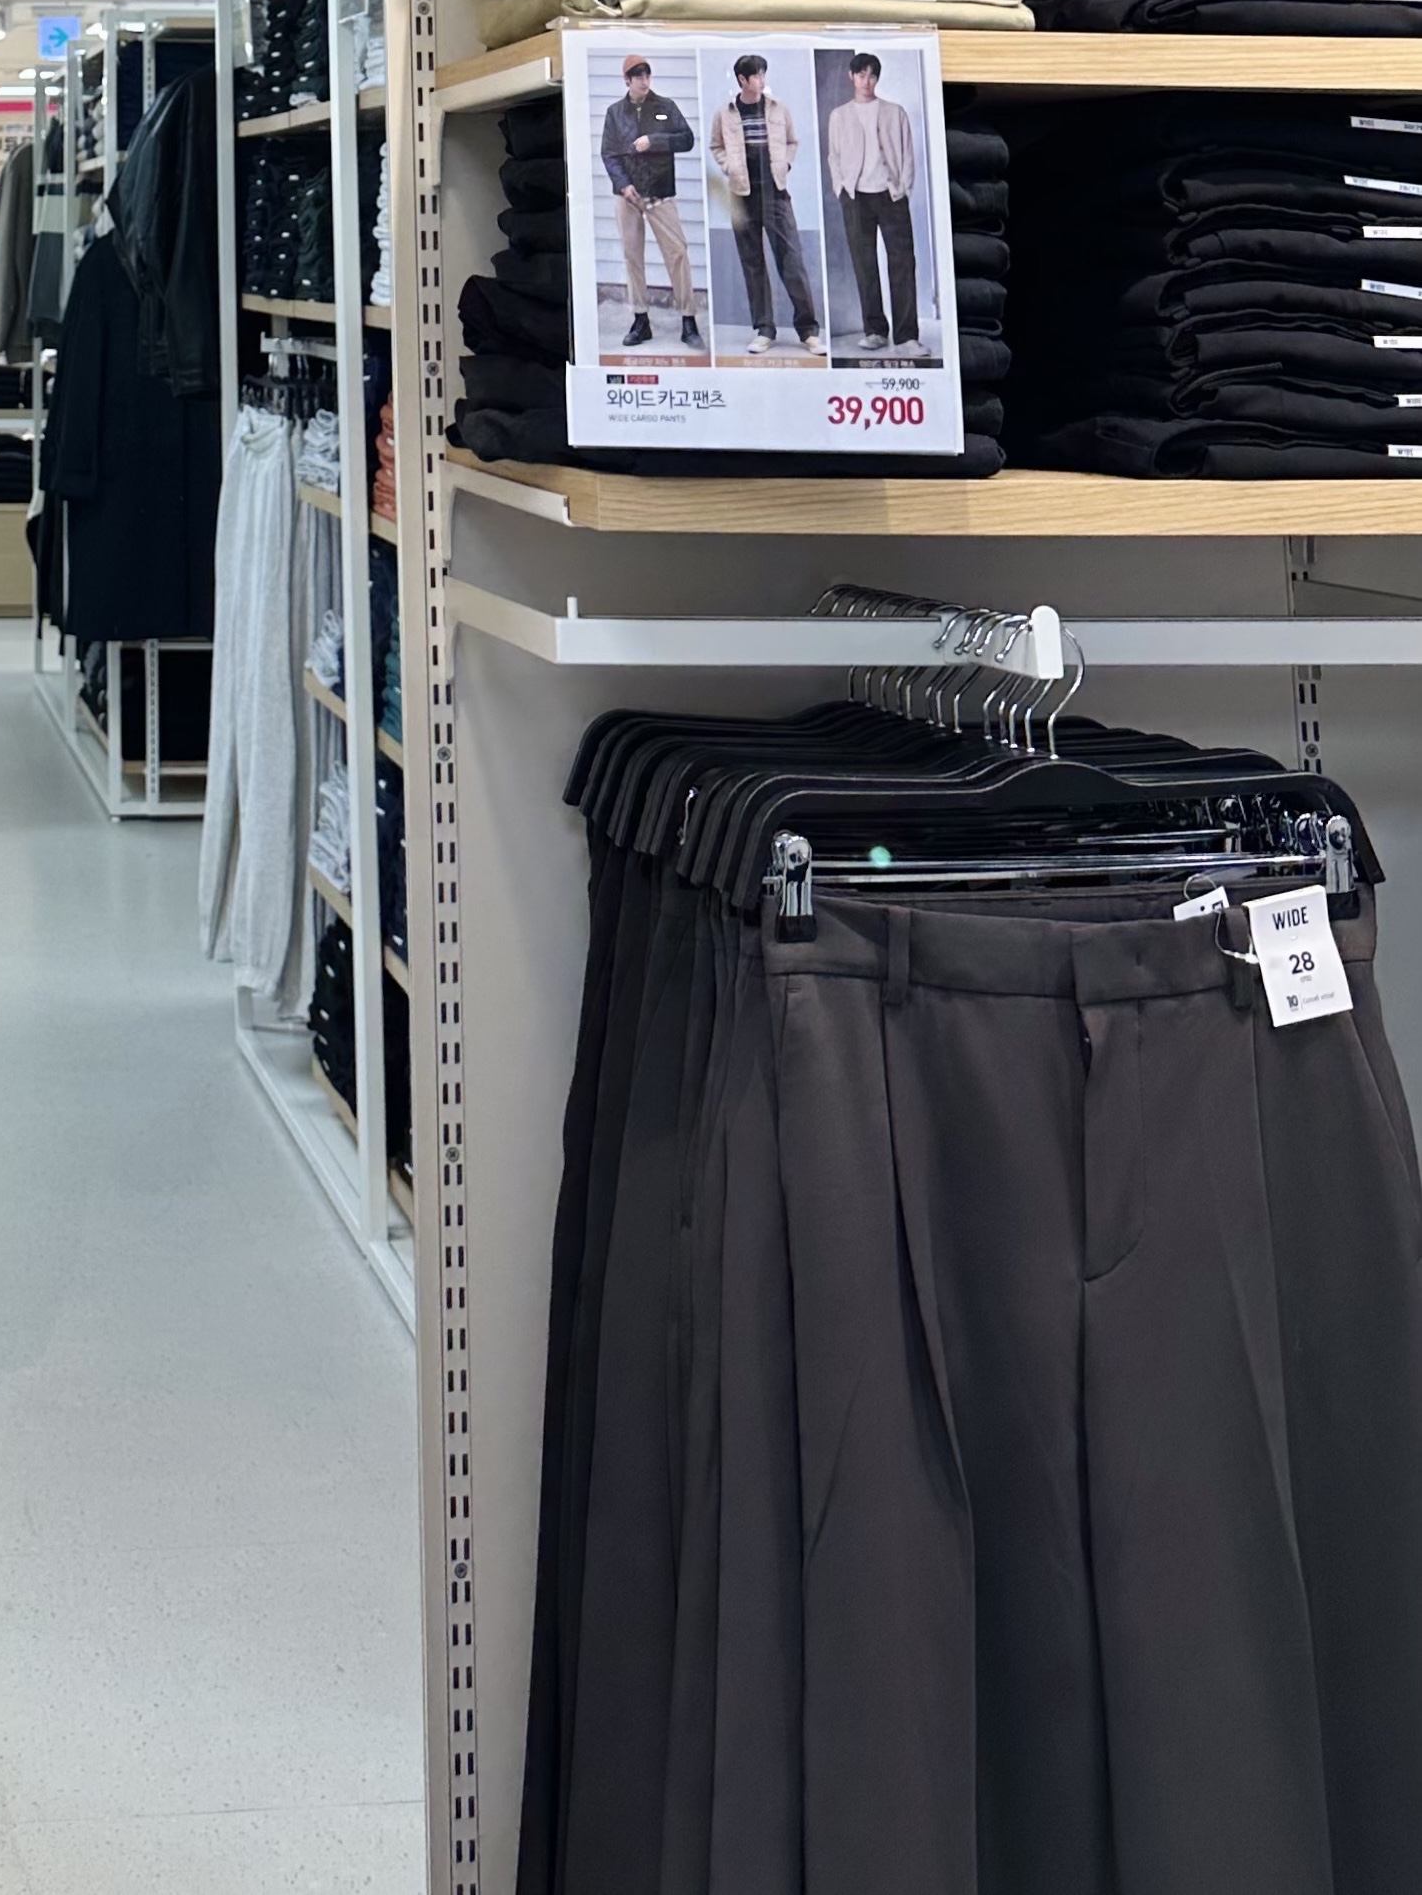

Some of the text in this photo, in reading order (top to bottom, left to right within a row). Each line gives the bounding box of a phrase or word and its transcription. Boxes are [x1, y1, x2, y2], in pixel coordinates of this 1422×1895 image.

[881, 378, 919, 391] 59,900
[607, 389, 726, 410] 와이드 카고 팬츠
[827, 396, 924, 430] 39,900
[1272, 906, 1309, 931] WIDE
[1288, 951, 1315, 975] 28
